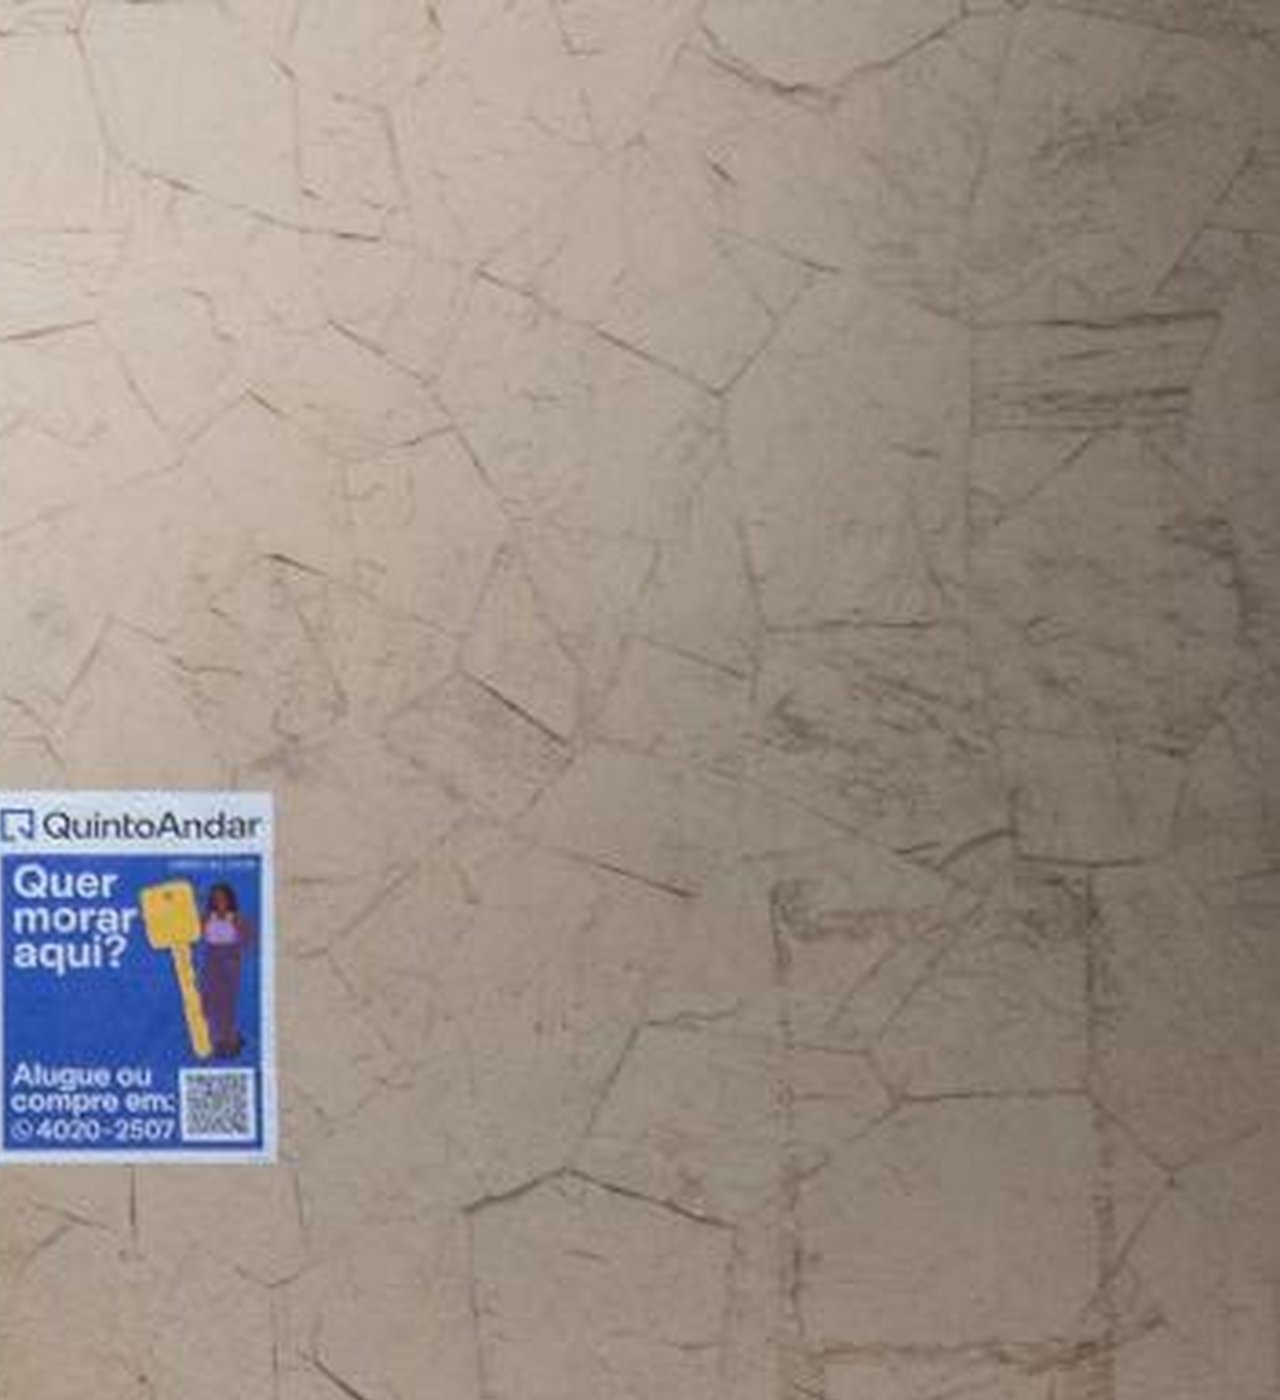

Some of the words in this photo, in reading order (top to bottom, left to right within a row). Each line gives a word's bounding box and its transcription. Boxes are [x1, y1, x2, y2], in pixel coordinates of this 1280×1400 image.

[42, 812, 262, 841] QuintoAndar
[13, 864, 119, 899] Quer
[13, 906, 138, 933] morar
[13, 937, 128, 975] aqui?
[11, 1063, 111, 1091] Alugue
[116, 1066, 153, 1087] ou
[10, 1091, 118, 1116] compre
[124, 1092, 176, 1112] em:
[36, 1118, 175, 1141] 4020-2507
